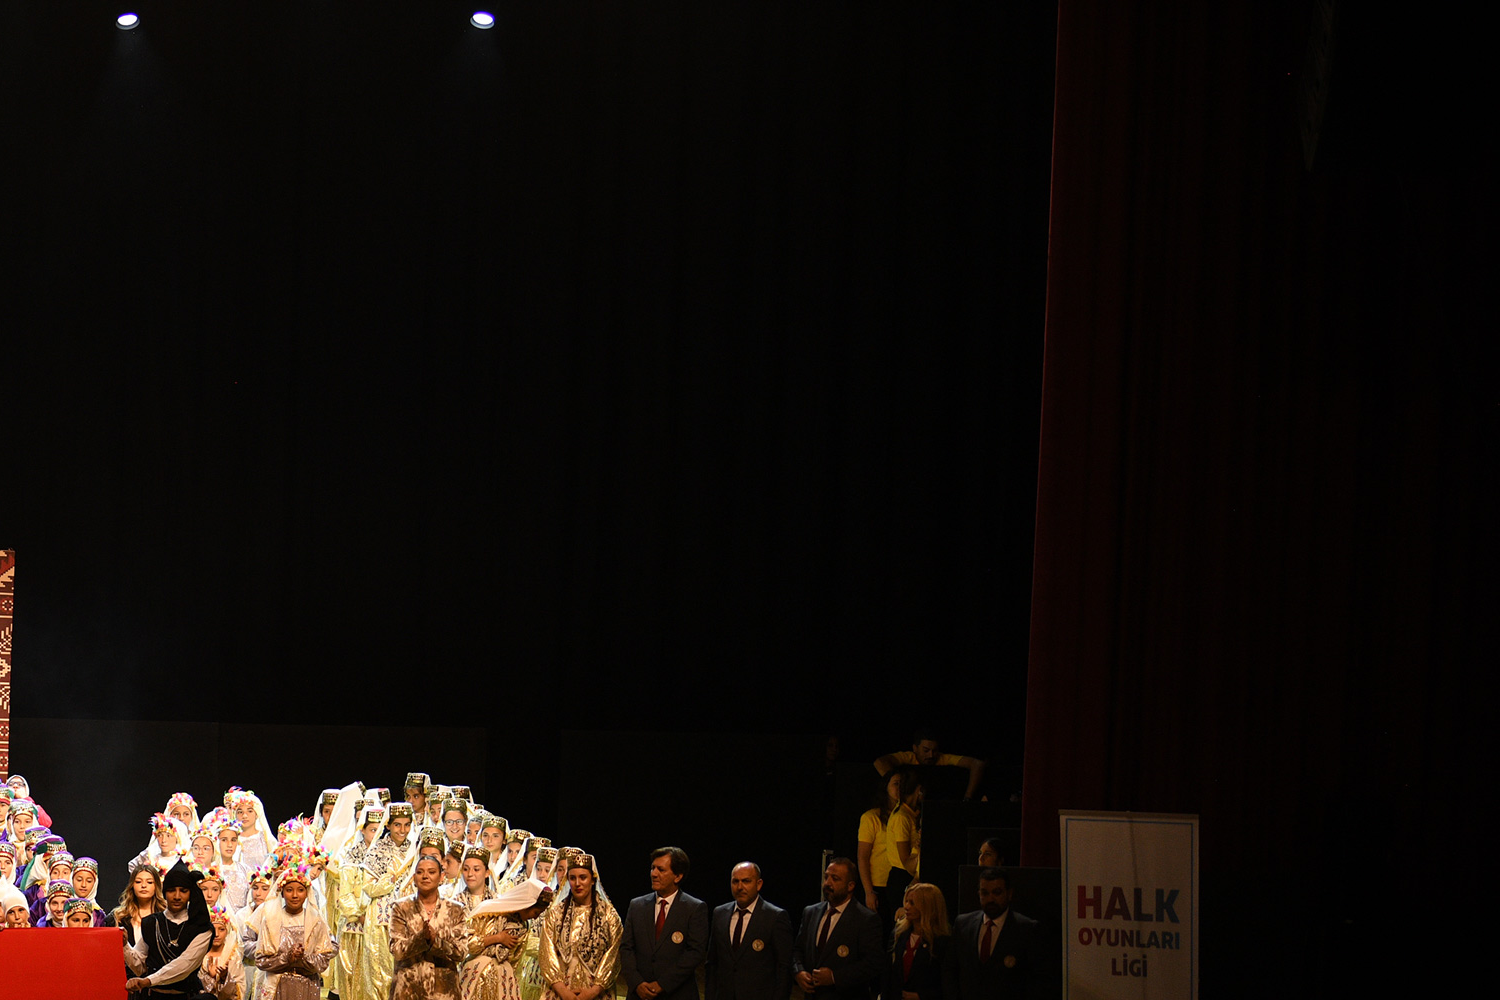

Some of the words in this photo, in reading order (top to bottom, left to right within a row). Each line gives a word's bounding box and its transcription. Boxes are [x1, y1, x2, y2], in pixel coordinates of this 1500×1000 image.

[1077, 885, 1180, 923] HALK
[1078, 927, 1180, 950] OYUNLARI
[1111, 953, 1148, 977] LİGİ
